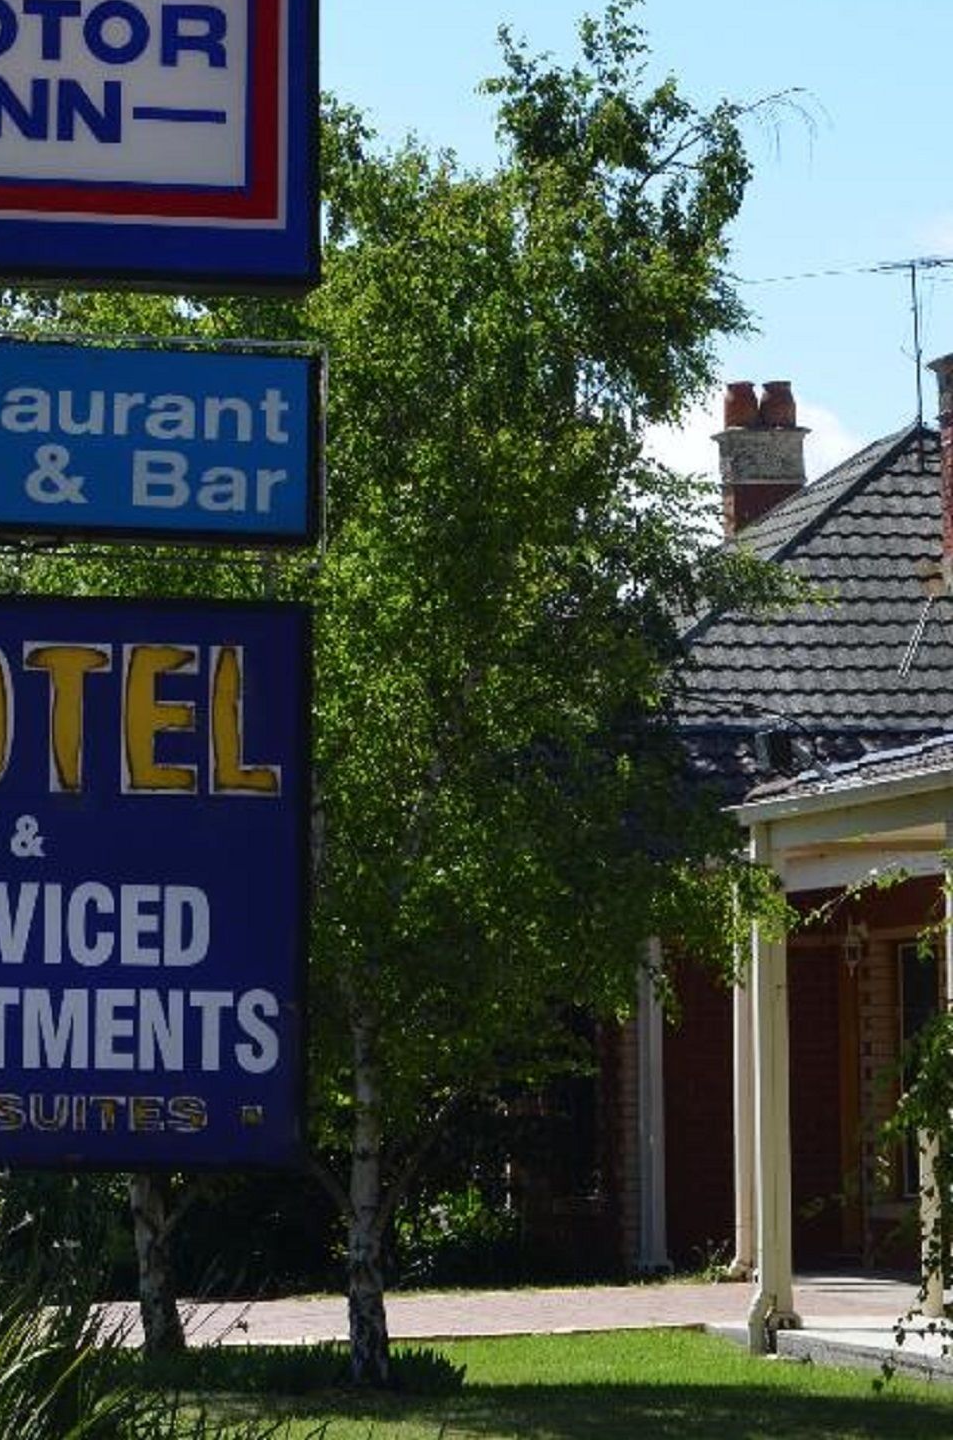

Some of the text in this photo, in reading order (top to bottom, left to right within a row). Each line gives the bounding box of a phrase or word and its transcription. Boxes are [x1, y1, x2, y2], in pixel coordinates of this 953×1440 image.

[24, 444, 287, 513] & Bar
[10, 814, 45, 857] &
